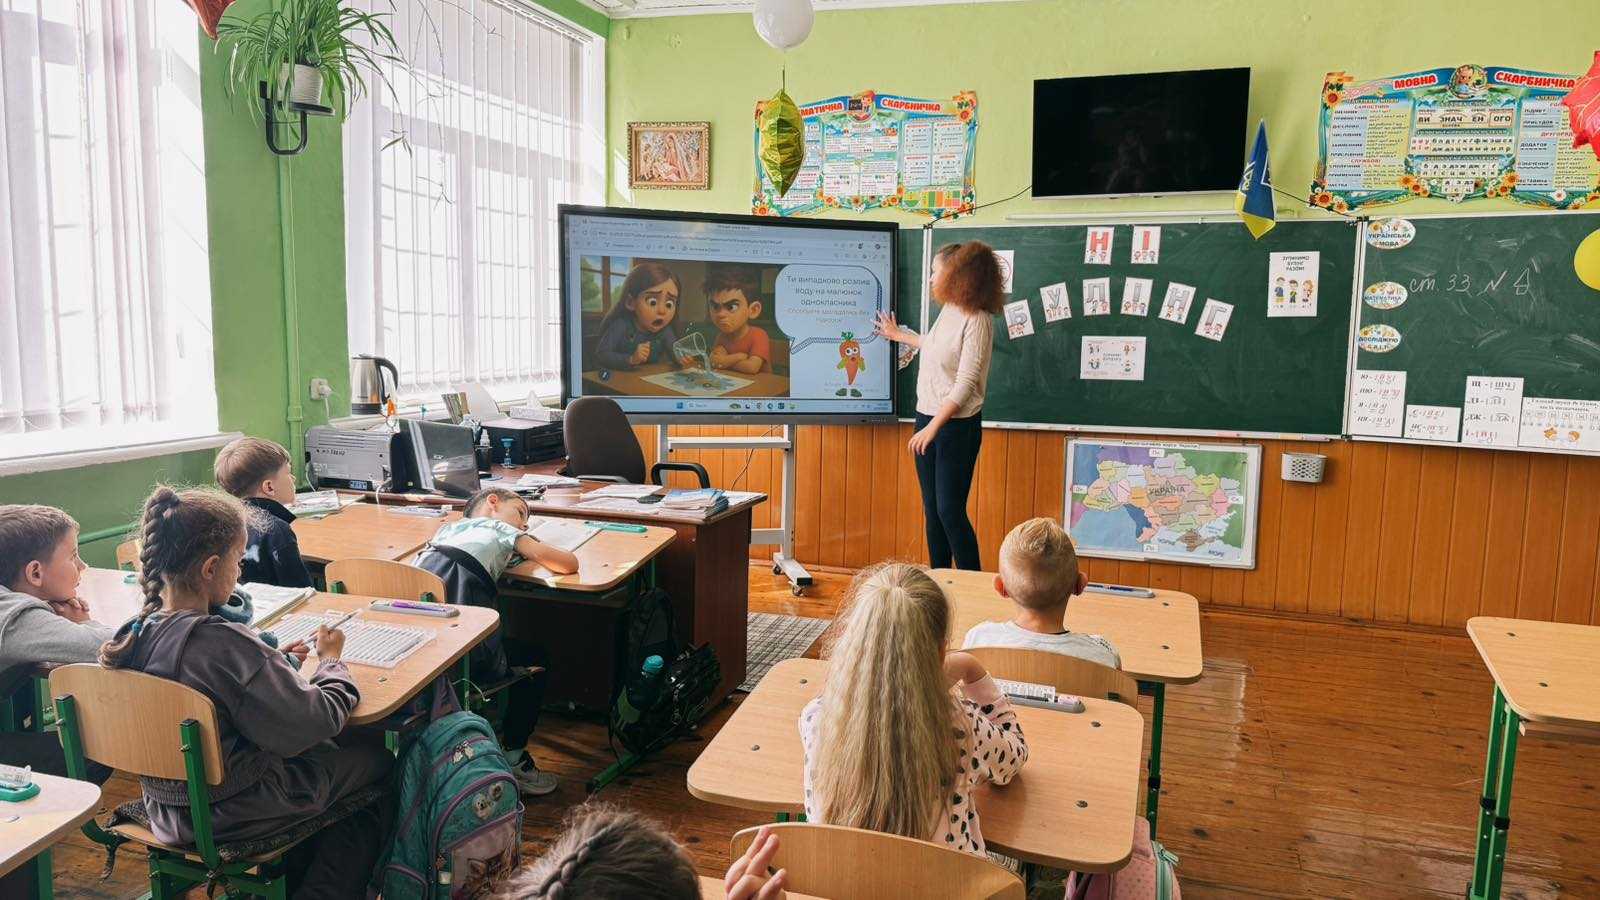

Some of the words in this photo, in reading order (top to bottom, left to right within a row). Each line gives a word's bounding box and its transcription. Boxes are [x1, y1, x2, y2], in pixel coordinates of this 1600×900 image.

[1394, 75, 1437, 88] МОВНА
[1496, 72, 1575, 89] СКАРБНИЧКА
[800, 103, 842, 116] МАТИЧНА
[882, 99, 941, 112] СКАРБНИЧКА
[1090, 231, 1109, 251] Н
[1142, 231, 1151, 250] І
[796, 288, 813, 296] воду
[1446, 274, 1471, 293] 33
[1149, 484, 1185, 495] УКРАЇНА
